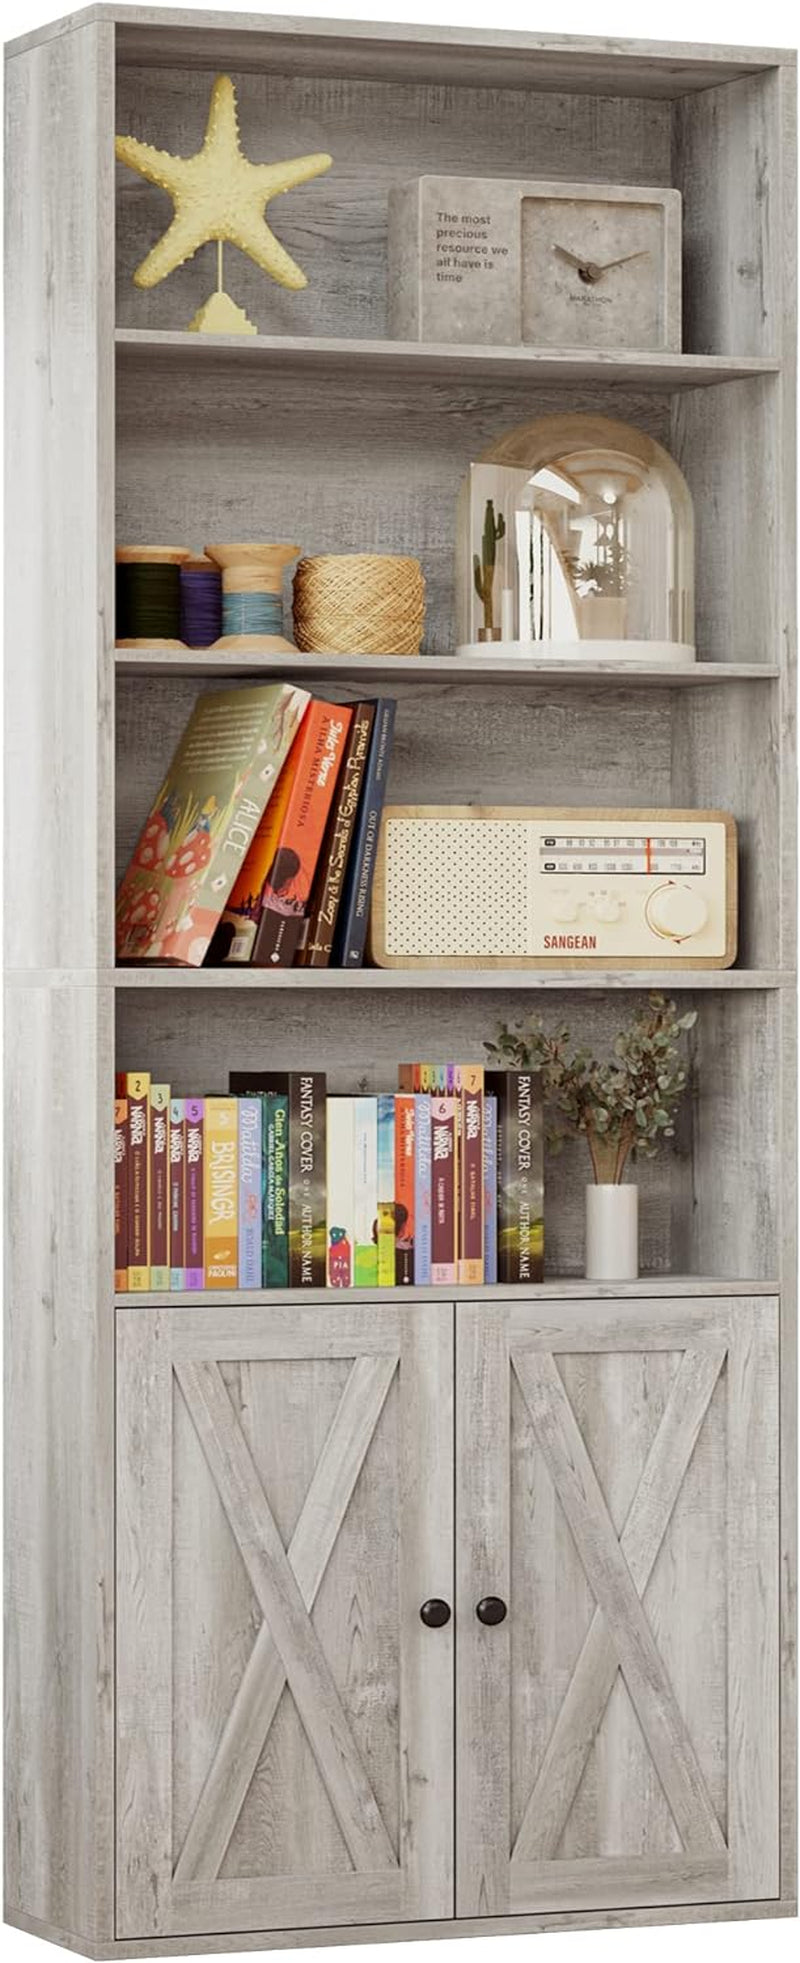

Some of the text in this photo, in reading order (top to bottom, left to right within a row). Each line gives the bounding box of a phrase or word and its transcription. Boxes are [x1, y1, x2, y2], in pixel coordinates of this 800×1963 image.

[436, 212, 491, 225] The most
[436, 228, 488, 240] precious
[436, 244, 508, 256] resource we
[436, 258, 494, 270] all have is
[436, 272, 463, 283] time
[317, 752, 337, 787] Verne
[296, 765, 318, 828] MISTERIOSA
[222, 798, 261, 857] ALICE
[355, 811, 377, 917] OUT OF DARKNESS RISING
[544, 935, 597, 950] SANGEAN
[135, 1080, 141, 1092] 2
[471, 1075, 476, 1086] 7
[157, 1093, 163, 1104] 3
[192, 1105, 198, 1116] 5
[300, 1077, 313, 1128] FANTASY
[439, 1102, 446, 1114] 6
[517, 1076, 531, 1126] FANTASY
[274, 1109, 286, 1137] Cien
[417, 1102, 431, 1177] Matilda
[240, 1107, 259, 1184] Matilda
[300, 1131, 313, 1173] COVER
[517, 1129, 531, 1170] COVER
[209, 1140, 235, 1224] BRISINGR
[274, 1187, 286, 1236] Soledad
[301, 1203, 312, 1247] AUTHOR
[519, 1202, 531, 1244] AUTHOR
[301, 1250, 312, 1283] NAME
[519, 1246, 530, 1279] NAME
